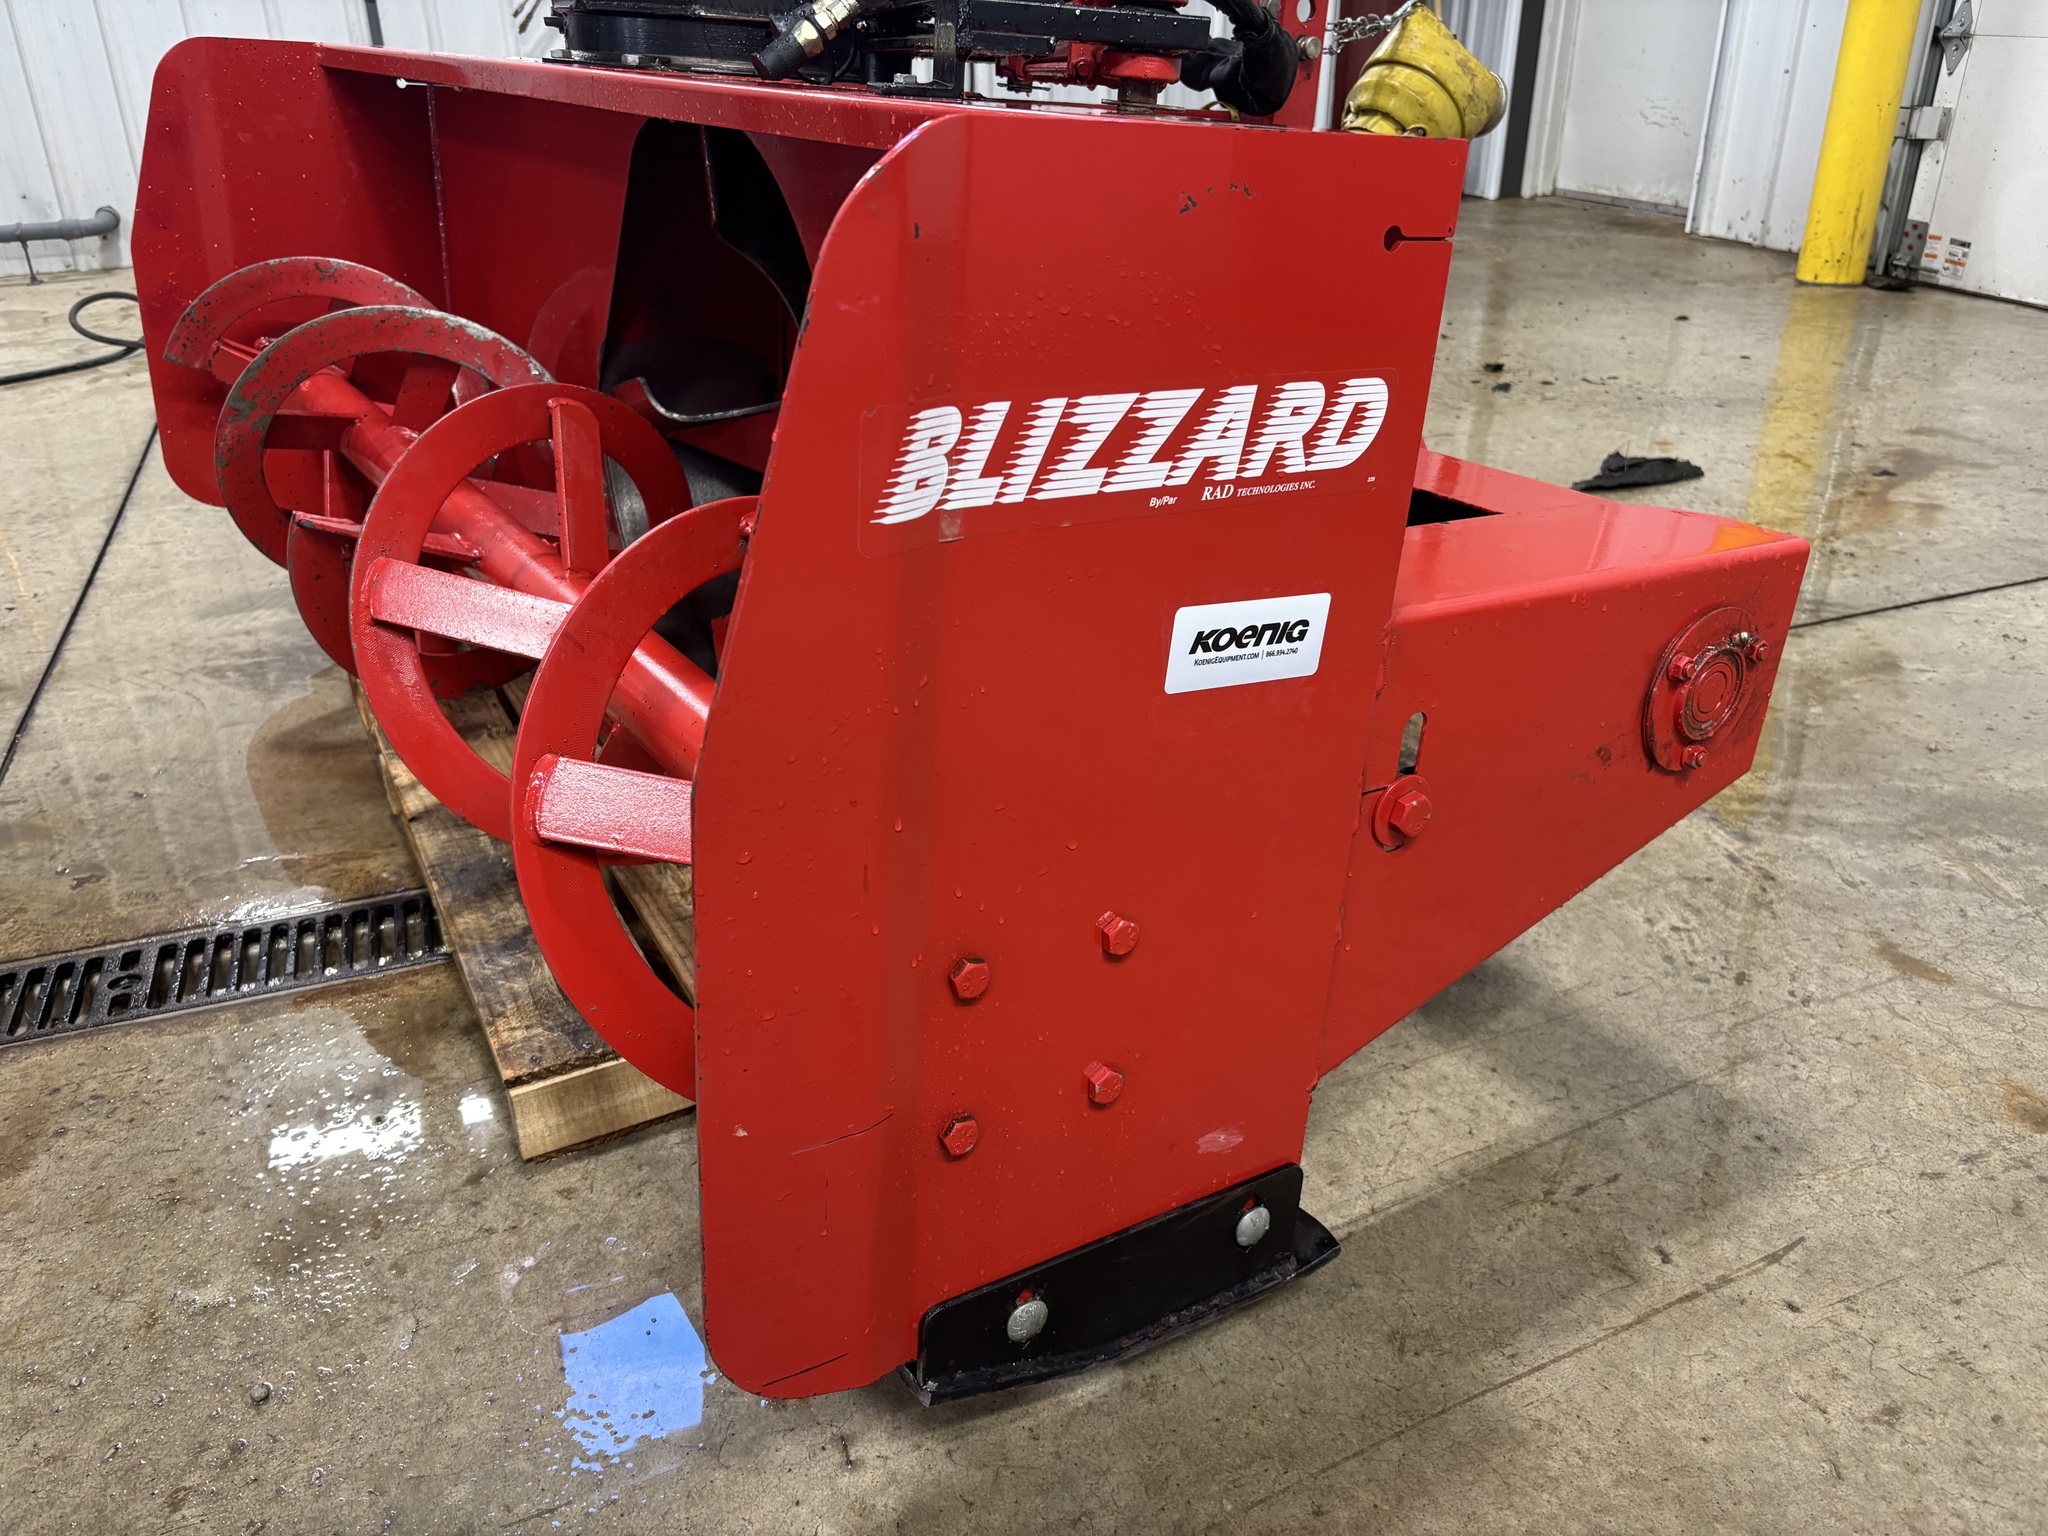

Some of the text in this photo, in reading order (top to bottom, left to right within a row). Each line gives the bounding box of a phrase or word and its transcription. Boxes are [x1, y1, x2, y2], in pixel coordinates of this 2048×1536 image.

[869, 377, 1389, 525] BLIZZARD
[1149, 480, 1316, 508] By/Par RAD TECHNOLOGIES INC.
